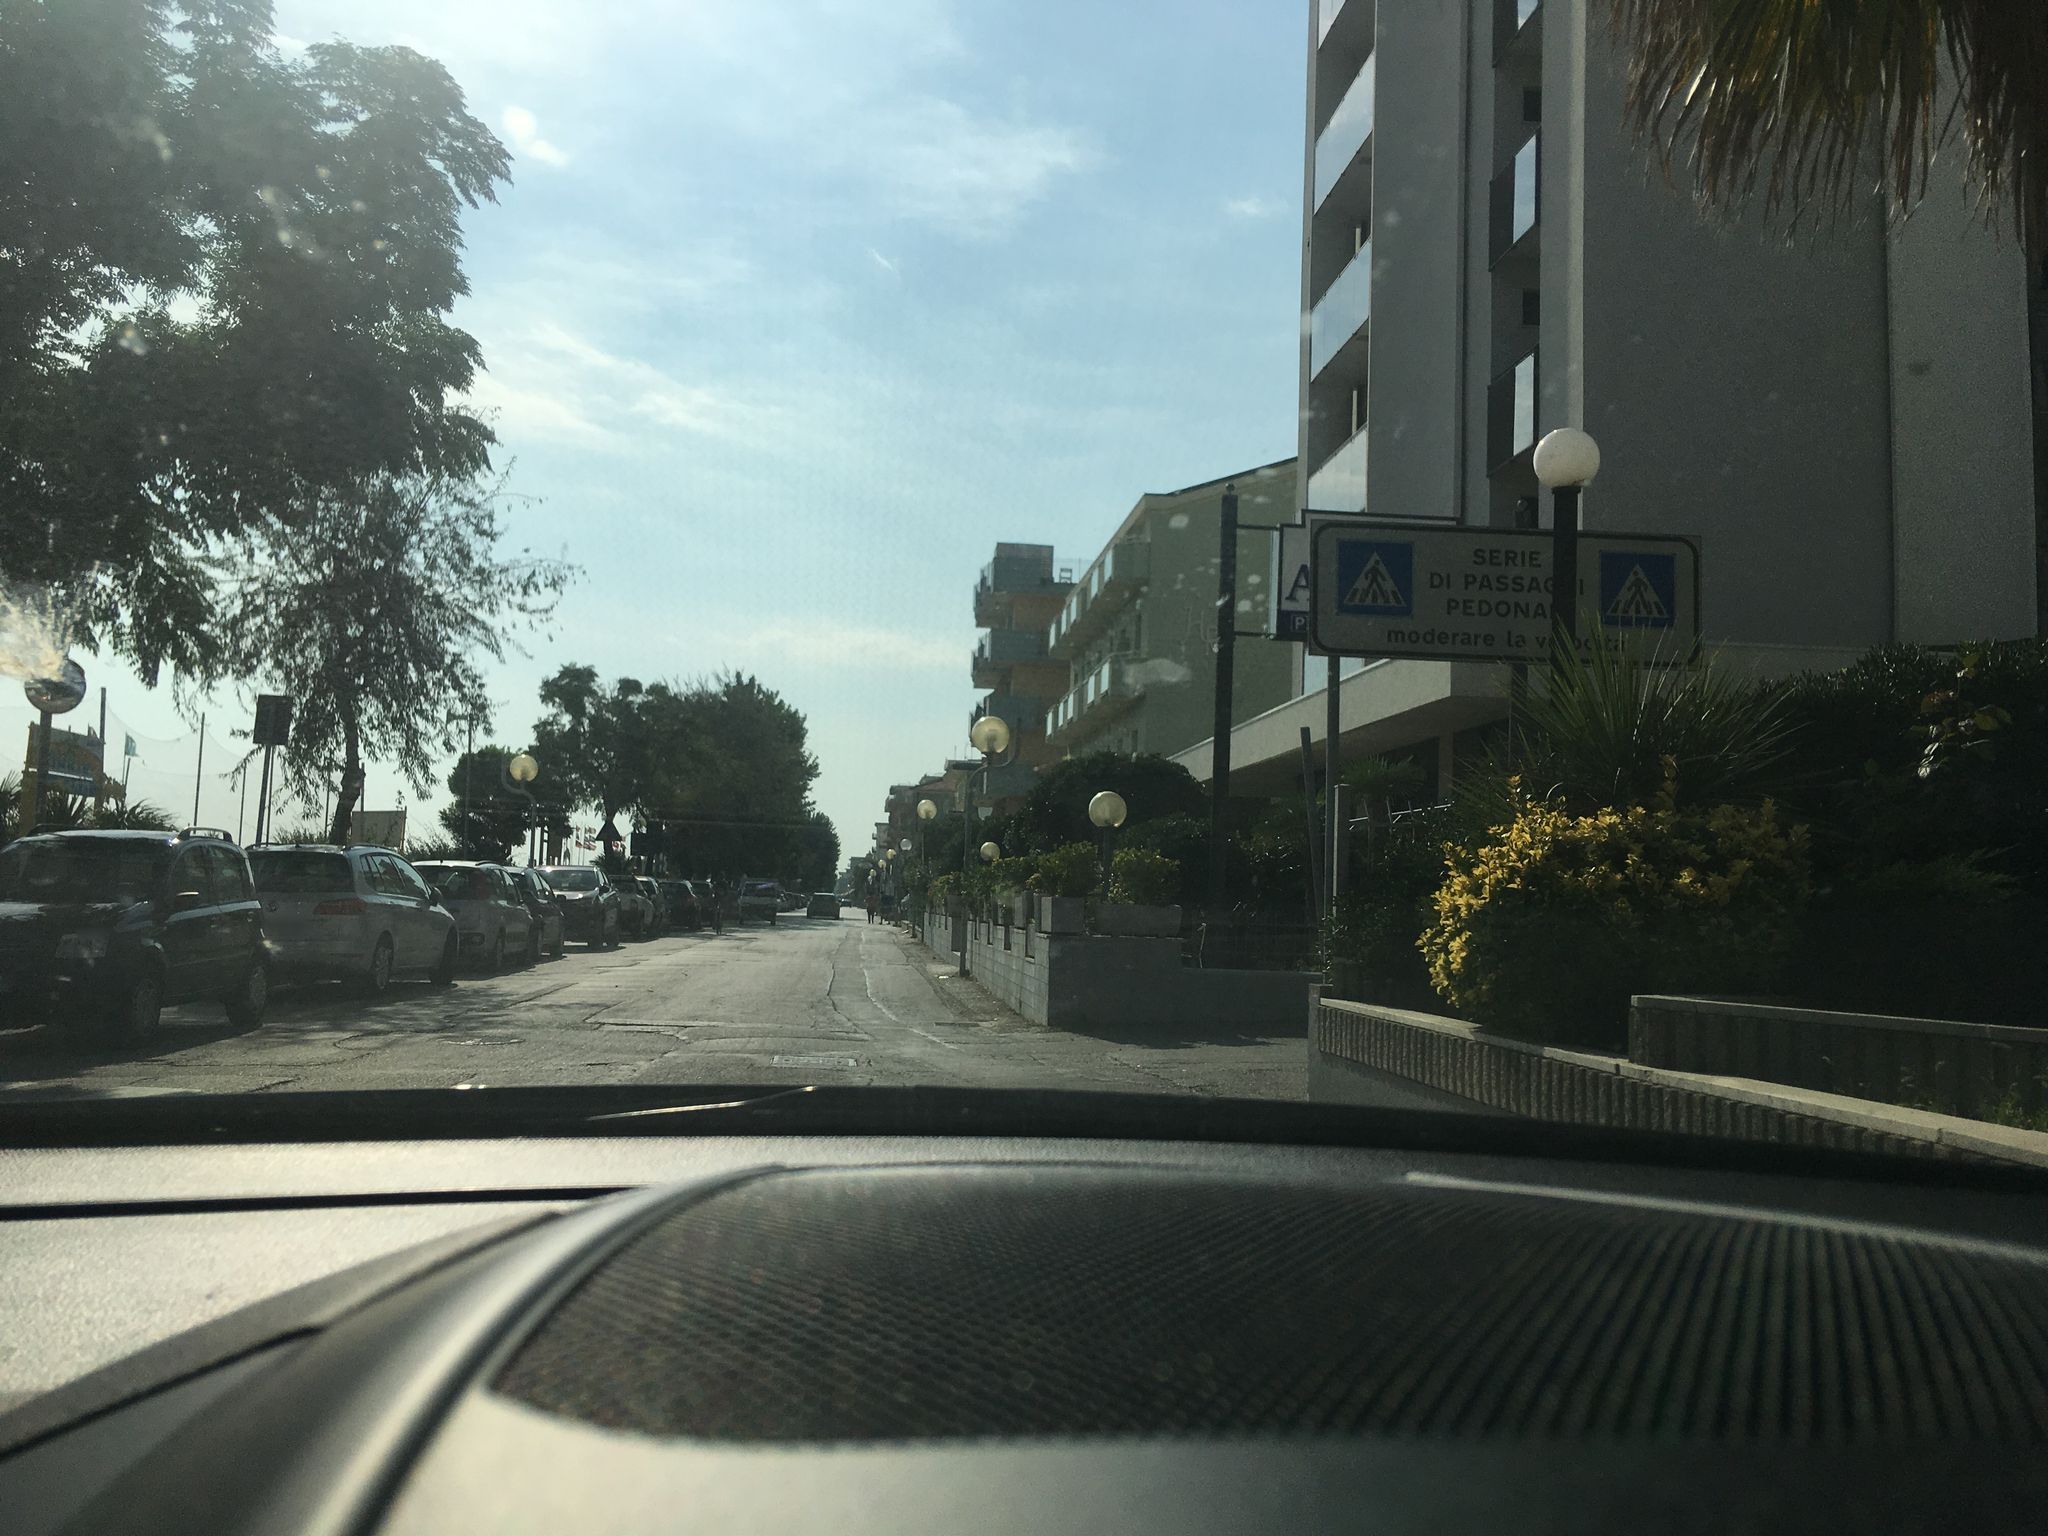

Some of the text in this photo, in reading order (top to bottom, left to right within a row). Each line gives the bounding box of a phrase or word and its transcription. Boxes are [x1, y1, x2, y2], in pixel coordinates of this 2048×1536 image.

[1471, 547, 1542, 568] SERIE
[1429, 571, 1585, 596] DI PASSAGI
[1386, 627, 1496, 647] moderare
[1507, 629, 1527, 648] la
